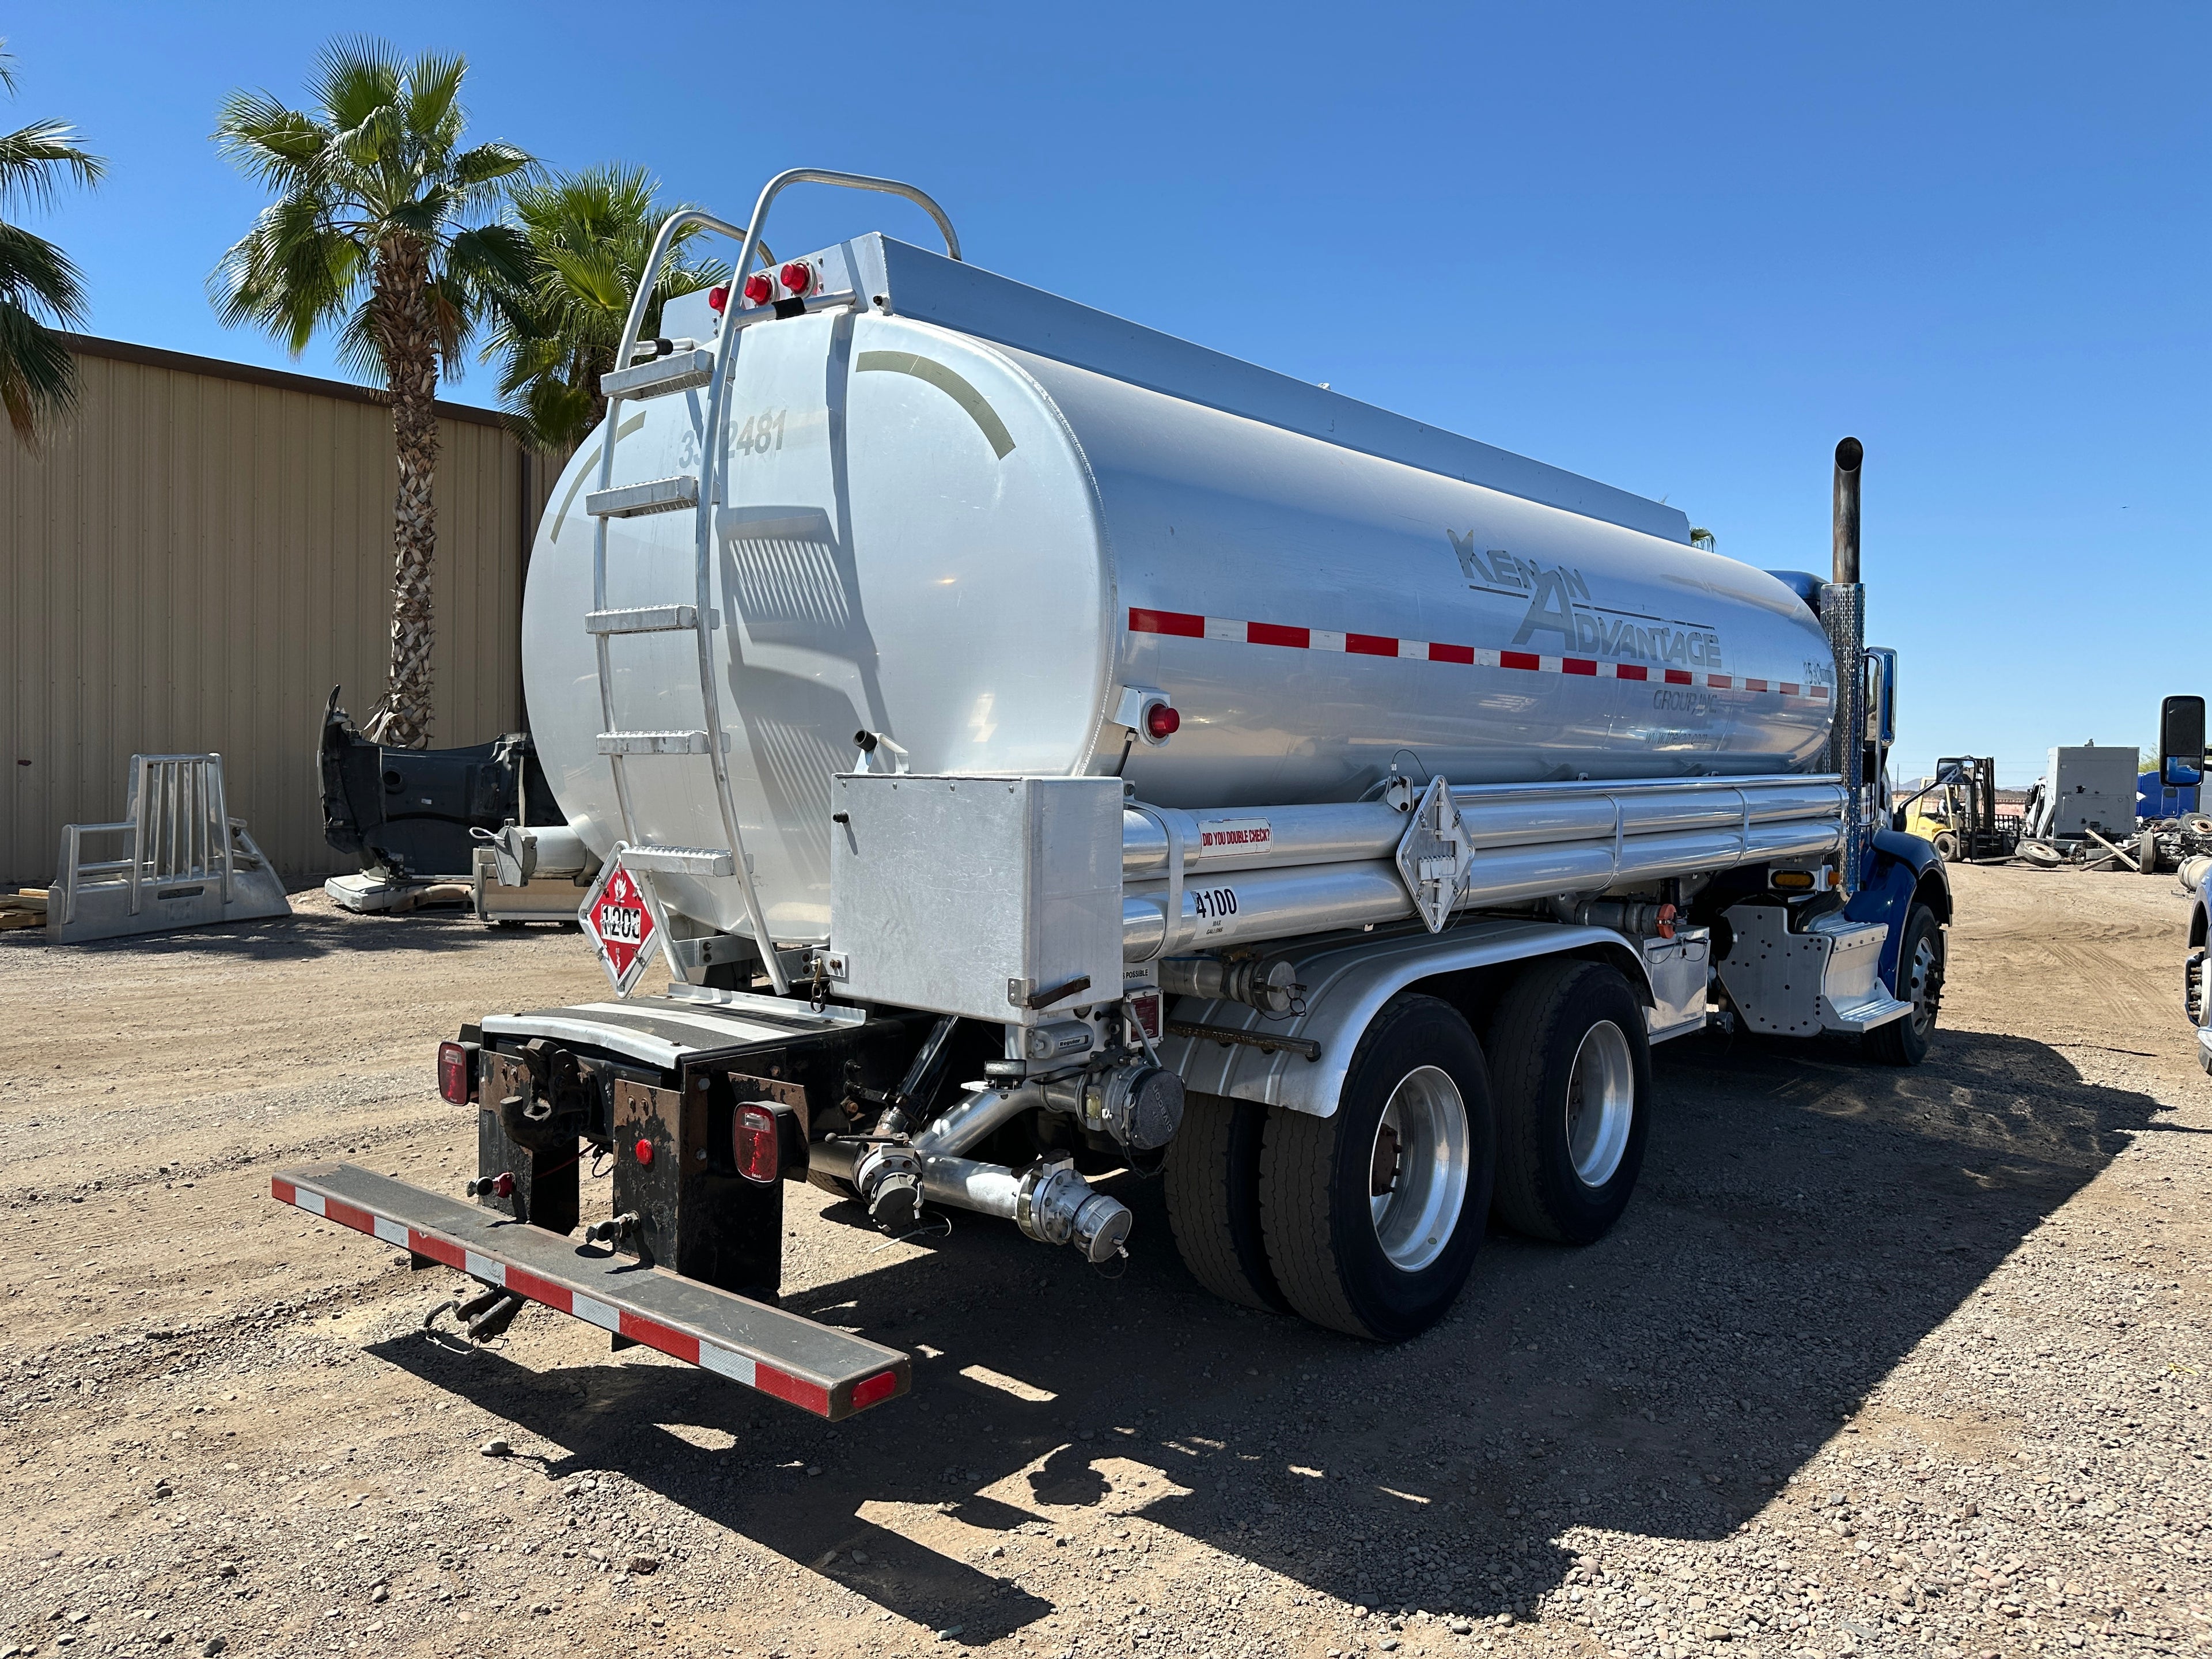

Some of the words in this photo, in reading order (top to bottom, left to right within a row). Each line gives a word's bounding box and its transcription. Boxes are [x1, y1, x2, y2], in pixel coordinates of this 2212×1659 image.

[679, 409, 786, 468] 32481
[1511, 569, 1722, 668] ADVANTAGE
[1202, 832, 1213, 847] DID
[1213, 831, 1225, 846] YOU
[1226, 830, 1248, 844] DOUBLE
[1249, 828, 1270, 843] CHECK?
[1196, 888, 1237, 918] 4100
[1126, 969, 1148, 979] POSSIBLE
